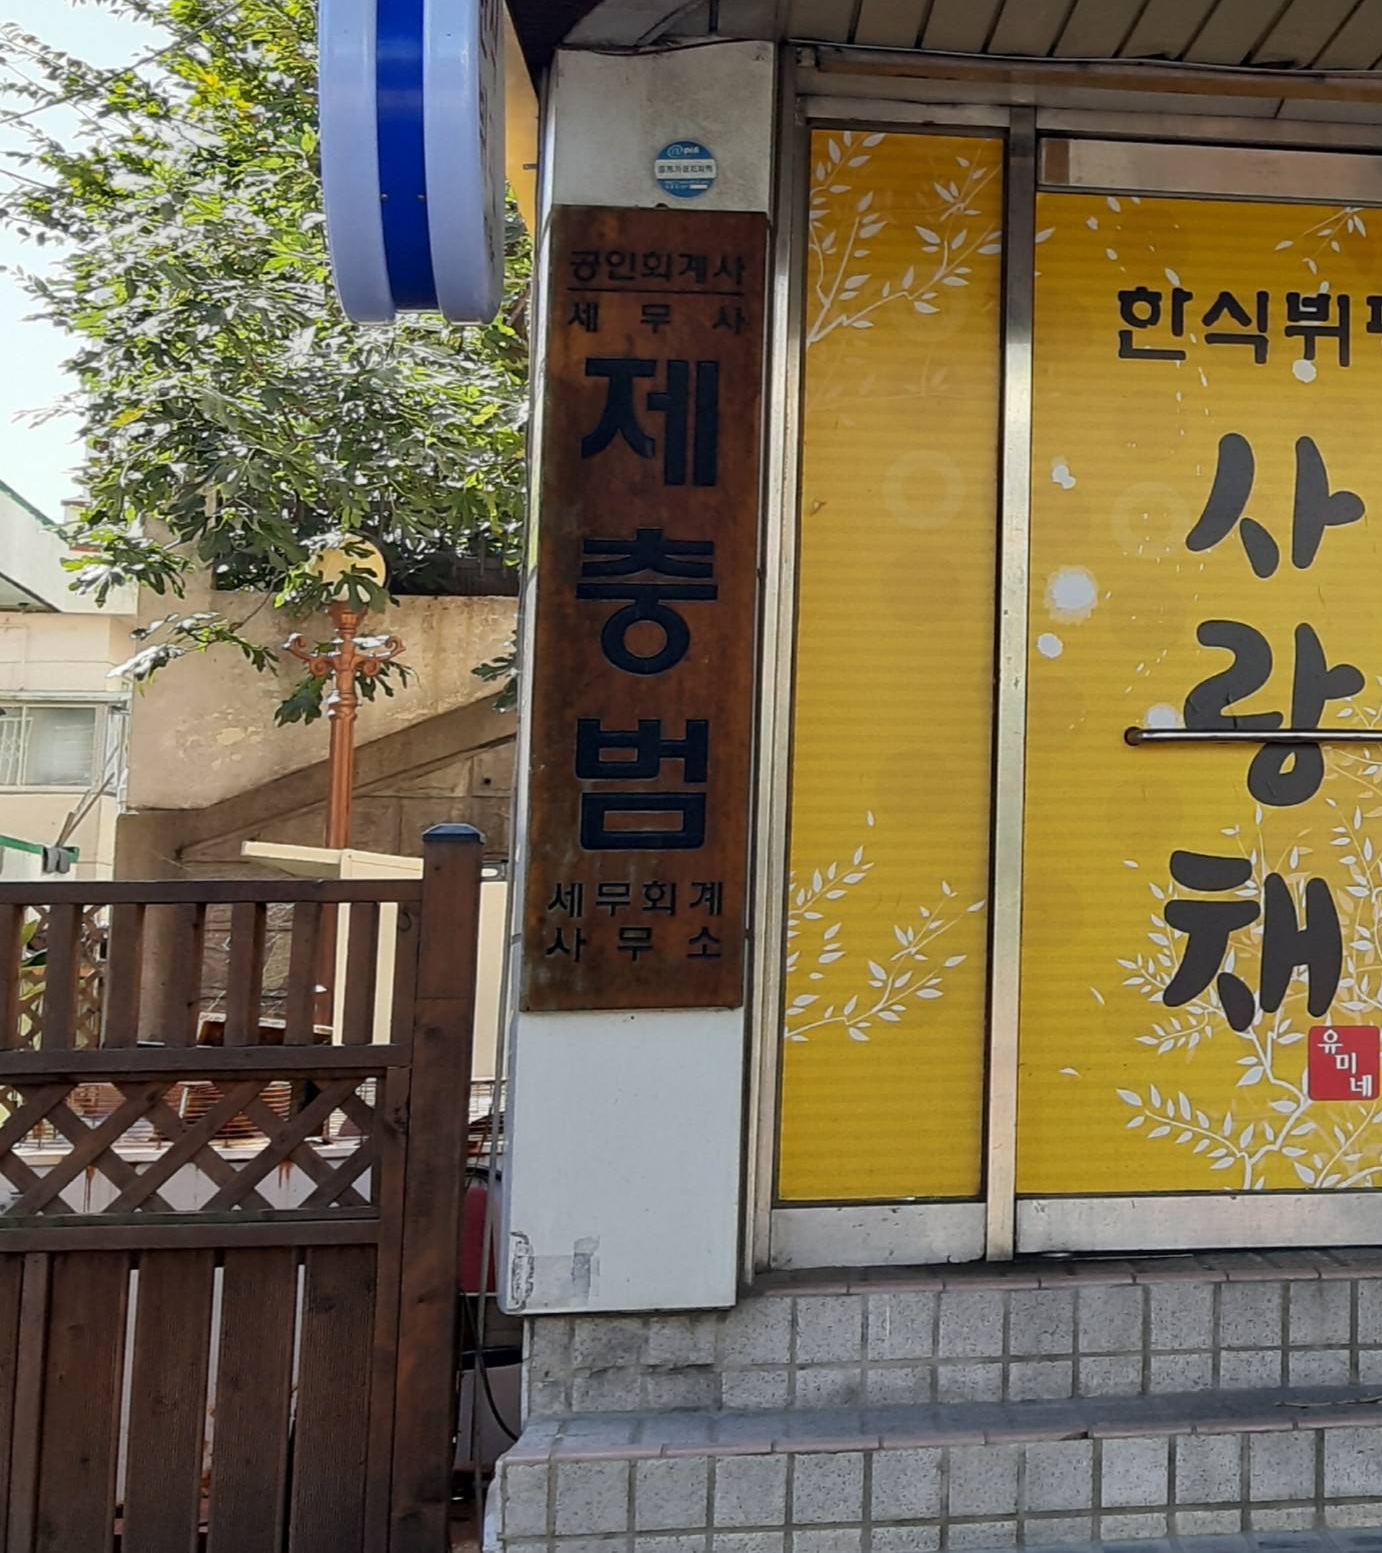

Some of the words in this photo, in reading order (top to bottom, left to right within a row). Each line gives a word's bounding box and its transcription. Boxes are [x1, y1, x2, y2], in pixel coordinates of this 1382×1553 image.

[568, 248, 747, 286] 공인회계사
[566, 300, 747, 336] 세무사
[574, 356, 720, 852] 제충범
[1162, 432, 1366, 1033] 사랑채
[546, 878, 724, 920] 세무회계
[545, 924, 723, 964] 사무소
[1316, 1027, 1375, 1099] 유미네
